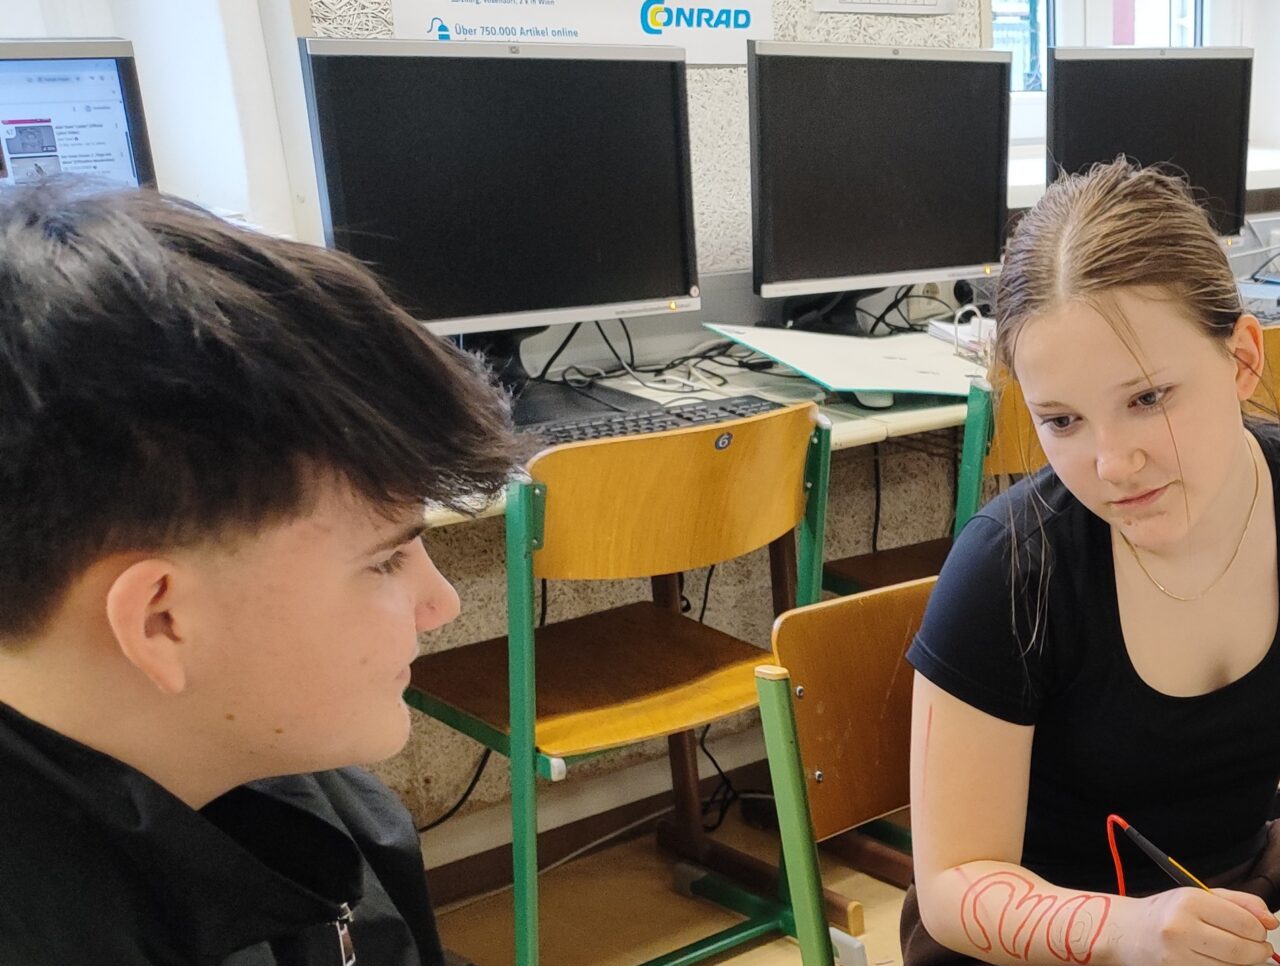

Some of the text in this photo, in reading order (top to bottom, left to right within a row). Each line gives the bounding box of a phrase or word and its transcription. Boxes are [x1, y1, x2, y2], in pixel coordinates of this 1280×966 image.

[640, 0, 751, 34] CONRAD
[454, 22, 579, 38] Über 750.000 Artikel online
